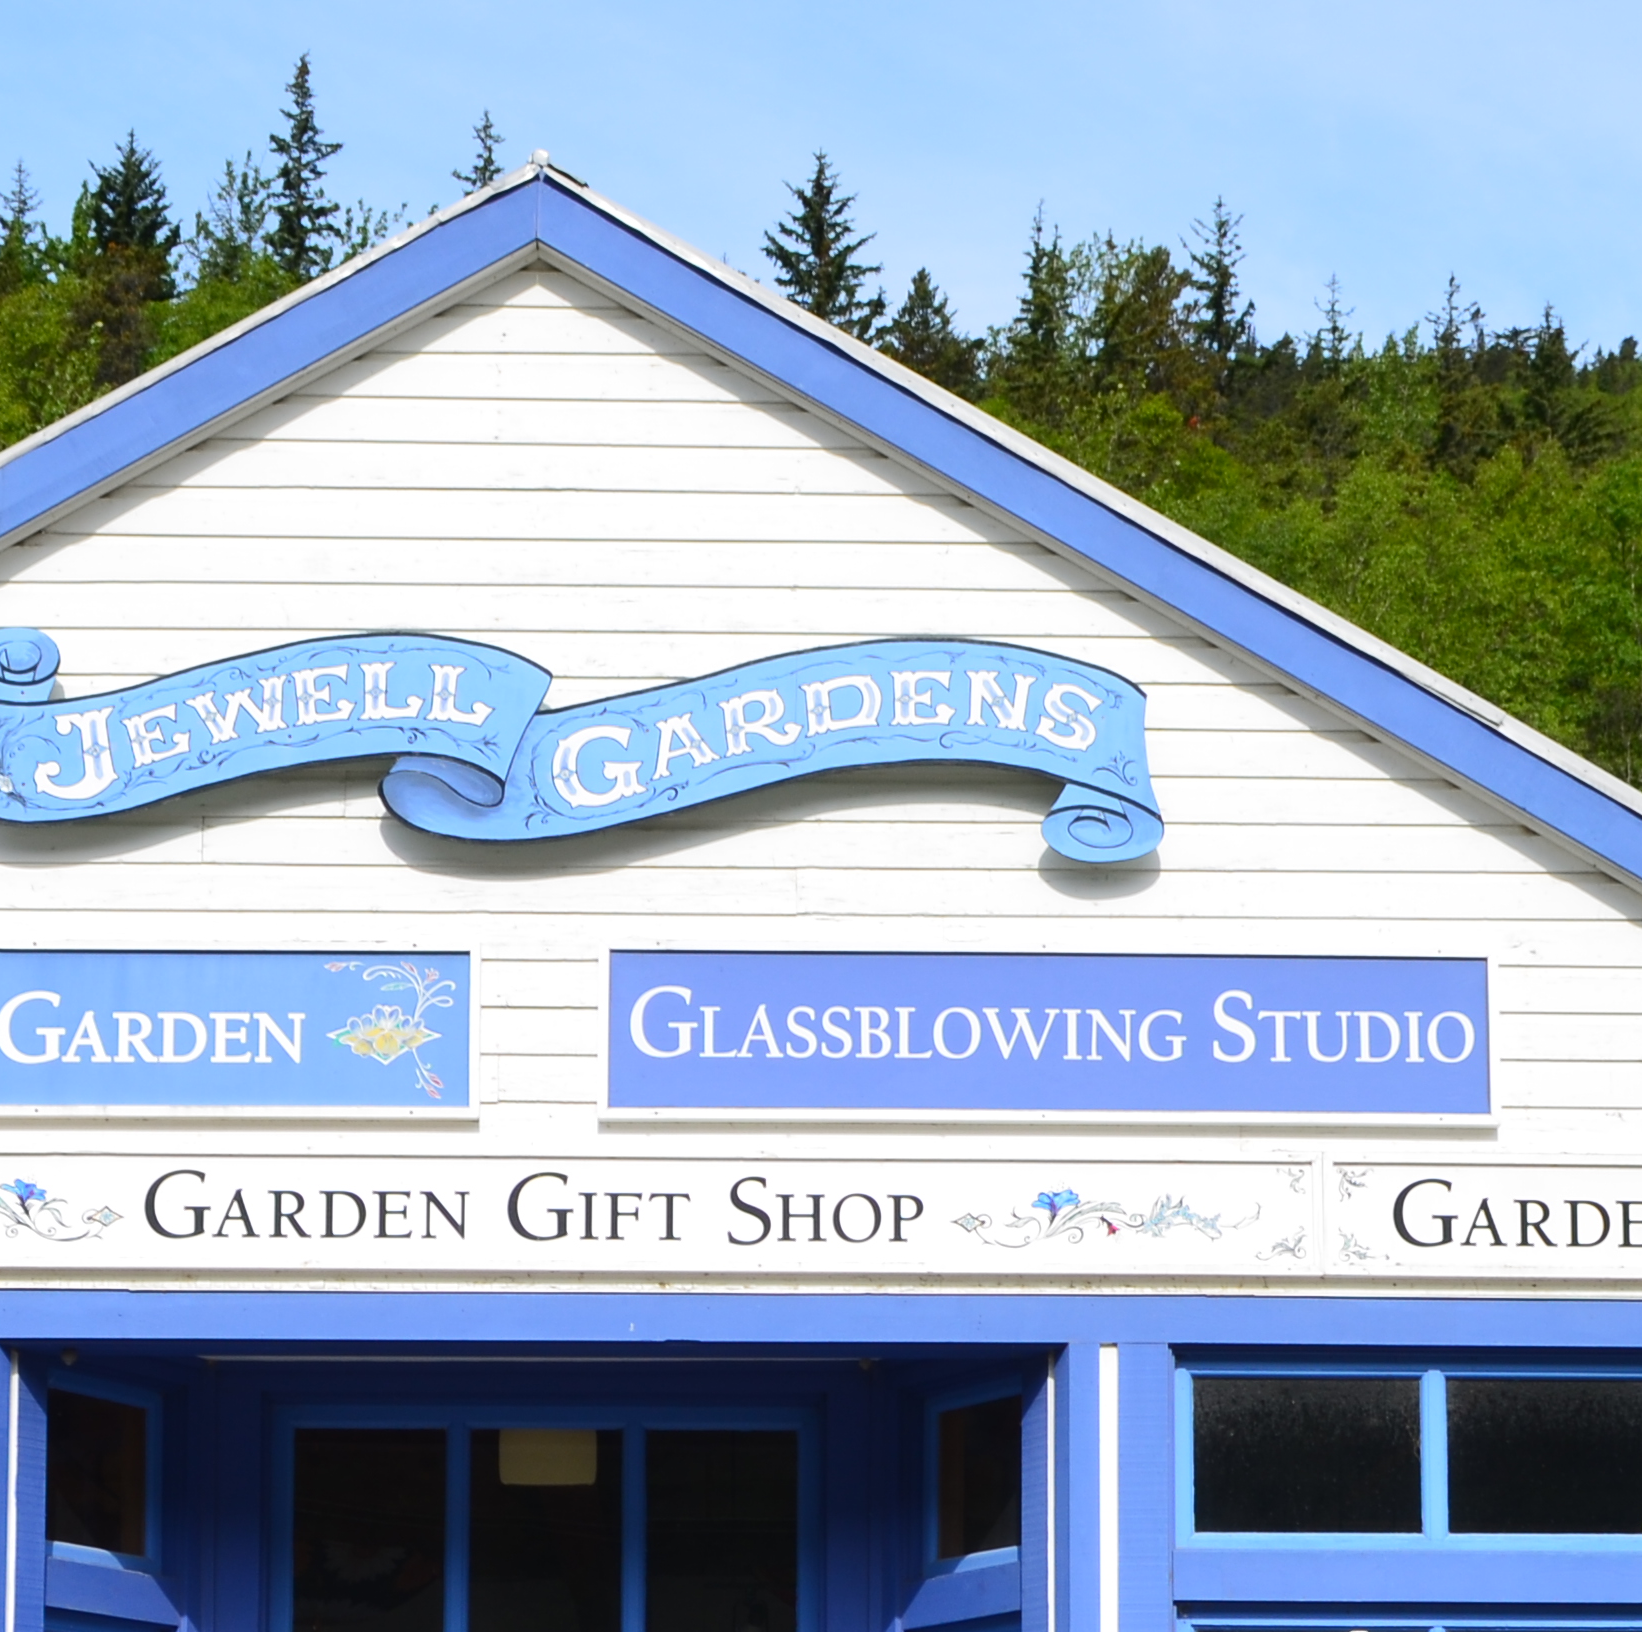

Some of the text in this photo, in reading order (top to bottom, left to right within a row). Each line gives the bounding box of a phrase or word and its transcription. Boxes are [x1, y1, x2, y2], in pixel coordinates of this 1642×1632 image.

[35, 664, 1101, 807] JEWELL GARDENS
[629, 986, 1475, 1063] GLASSBLOWING STUDIO
[144, 1169, 925, 1245] GARDEN GIFT SHOP
